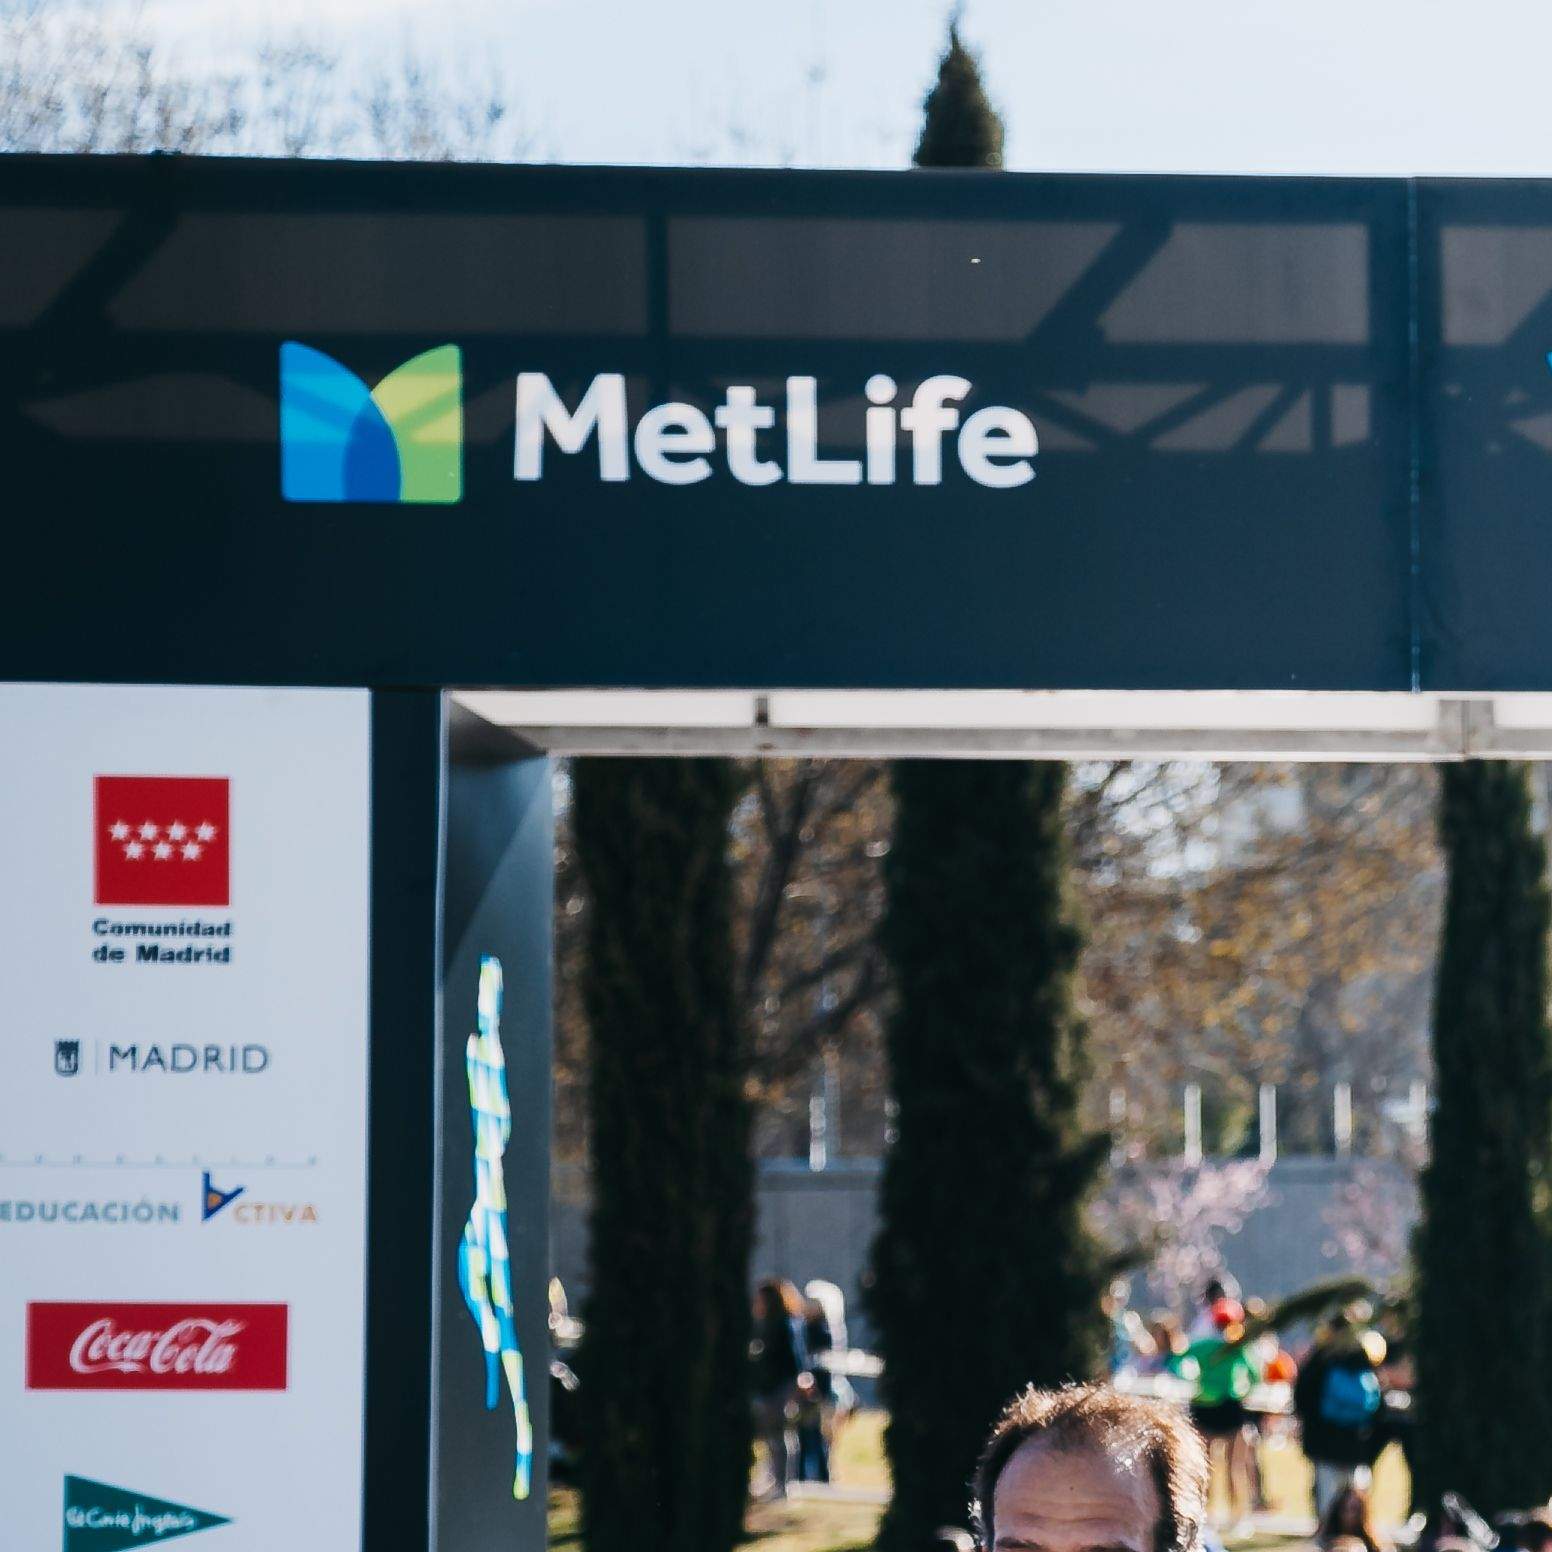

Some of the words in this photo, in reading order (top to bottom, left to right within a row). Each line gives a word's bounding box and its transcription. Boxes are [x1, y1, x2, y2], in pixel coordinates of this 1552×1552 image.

[513, 373, 1040, 489] MetLife
[92, 919, 232, 938] Comunidad
[93, 945, 126, 963] de
[136, 945, 232, 963] Madrid
[108, 1044, 270, 1074] MADRID
